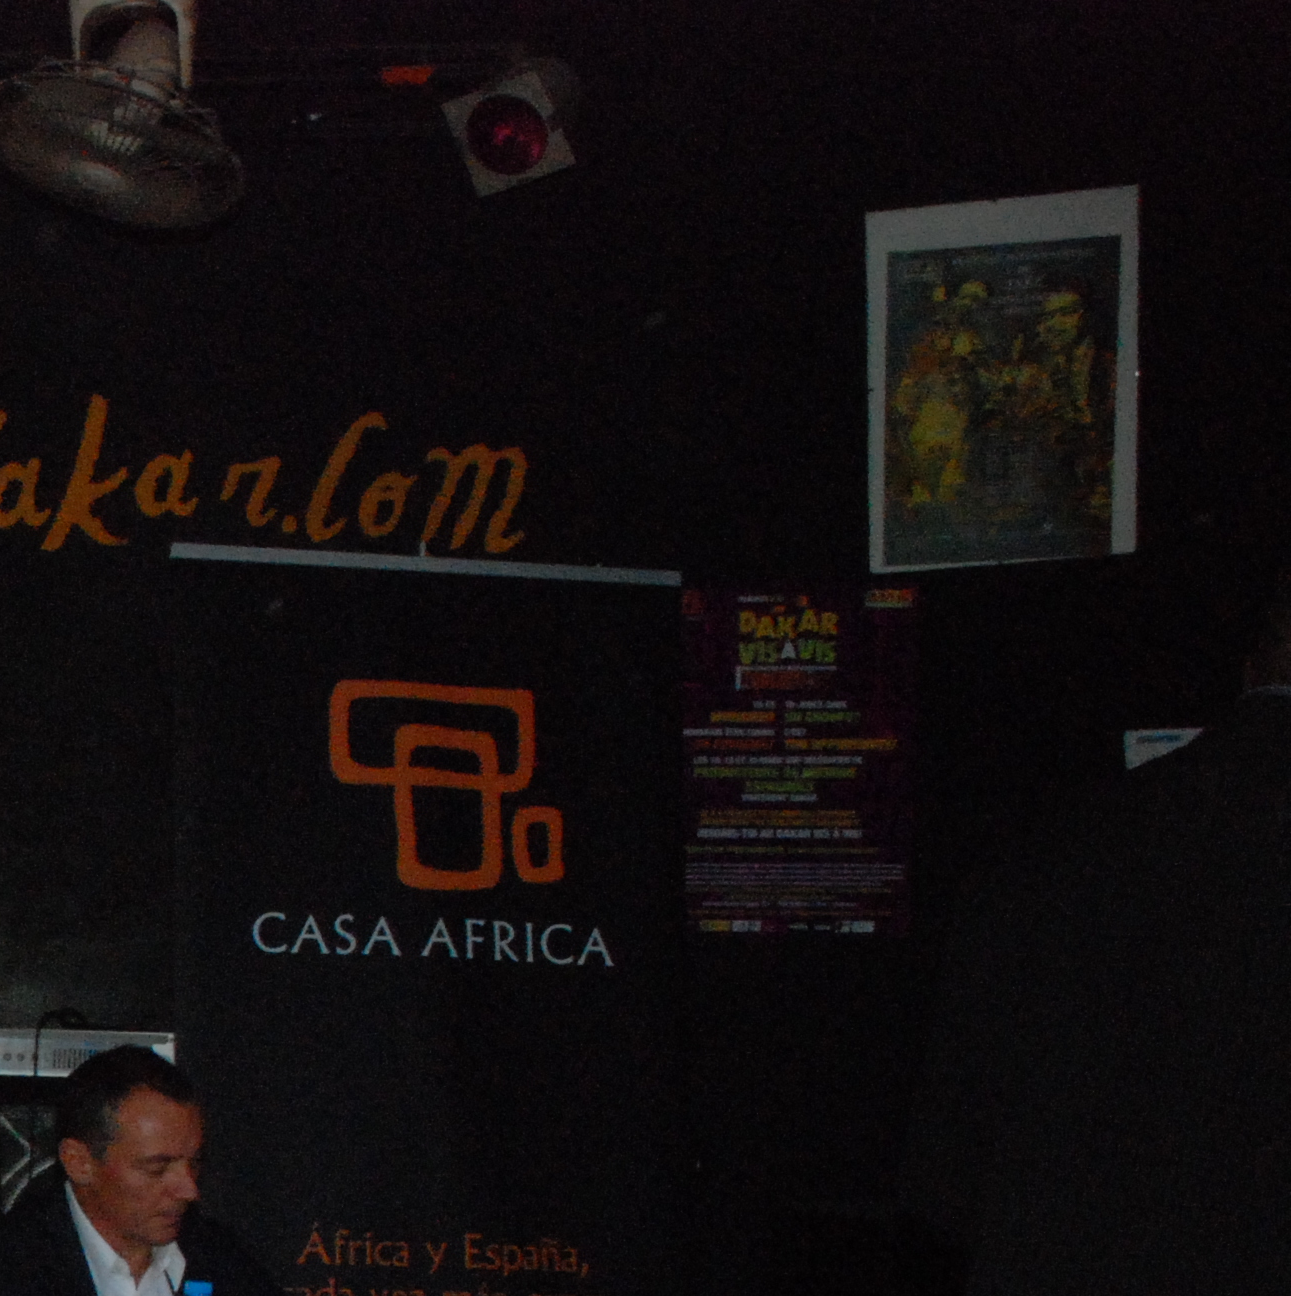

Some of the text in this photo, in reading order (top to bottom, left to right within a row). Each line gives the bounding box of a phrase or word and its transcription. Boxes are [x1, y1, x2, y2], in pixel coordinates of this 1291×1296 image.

[739, 609, 839, 638] DAKAR
[252, 911, 401, 956] CASA
[297, 1221, 590, 1278] África y España,
